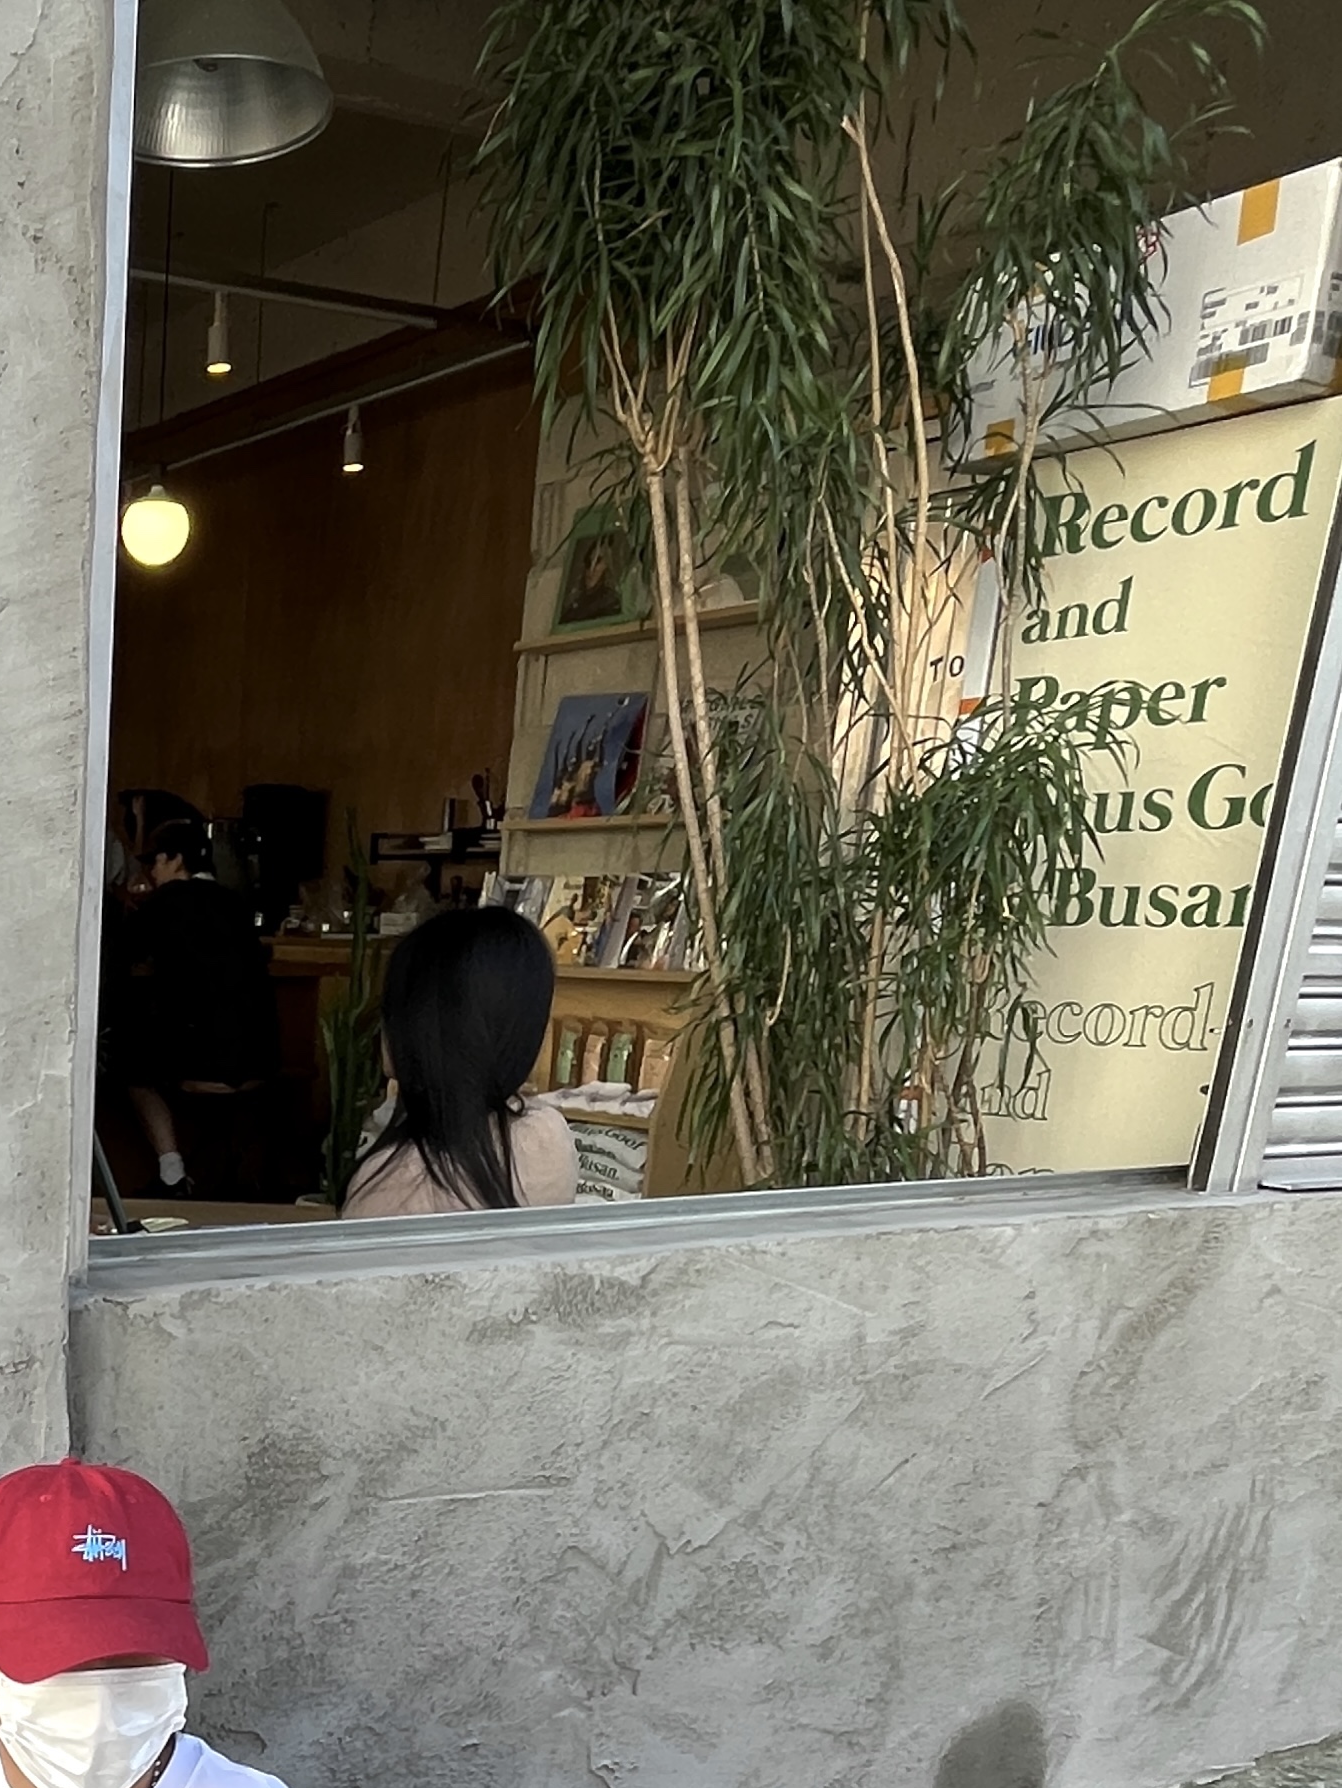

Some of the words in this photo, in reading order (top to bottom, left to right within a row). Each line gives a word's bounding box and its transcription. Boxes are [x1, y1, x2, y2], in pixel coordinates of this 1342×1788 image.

[1037, 439, 1317, 558] Record
[1021, 575, 1135, 645] and
[1010, 675, 1228, 752] Paper
[1088, 787, 1174, 834] us
